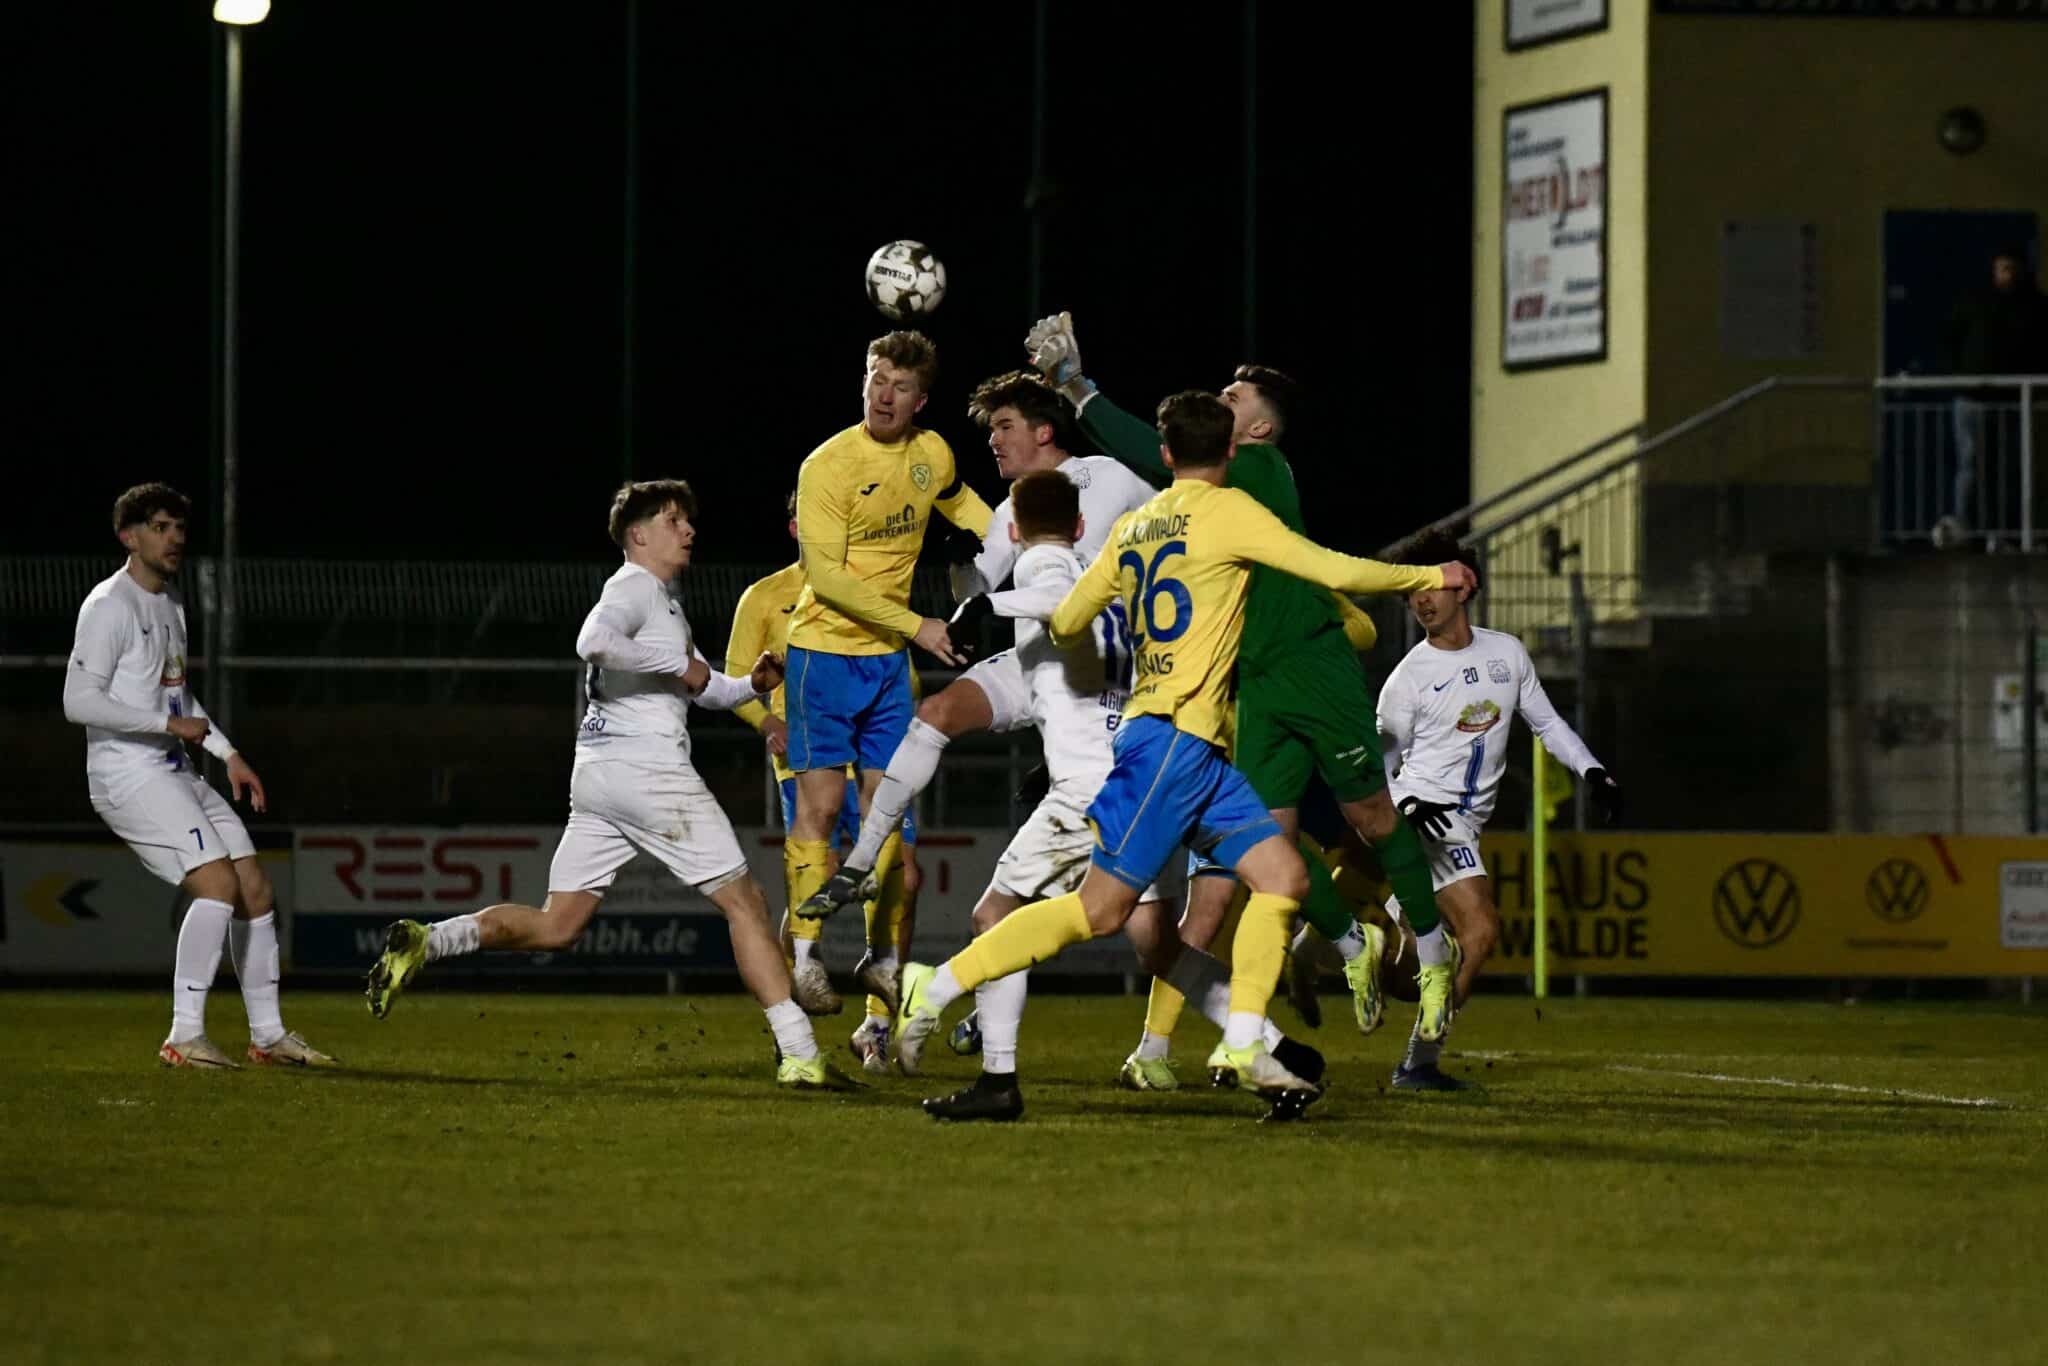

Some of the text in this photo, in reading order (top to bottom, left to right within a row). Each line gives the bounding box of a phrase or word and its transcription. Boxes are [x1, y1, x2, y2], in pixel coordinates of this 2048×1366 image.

[1119, 541, 1192, 649] 26
[1463, 667, 1479, 684] 20
[189, 827, 204, 851] 7
[302, 837, 541, 901] REST
[1450, 847, 1476, 870] 20
